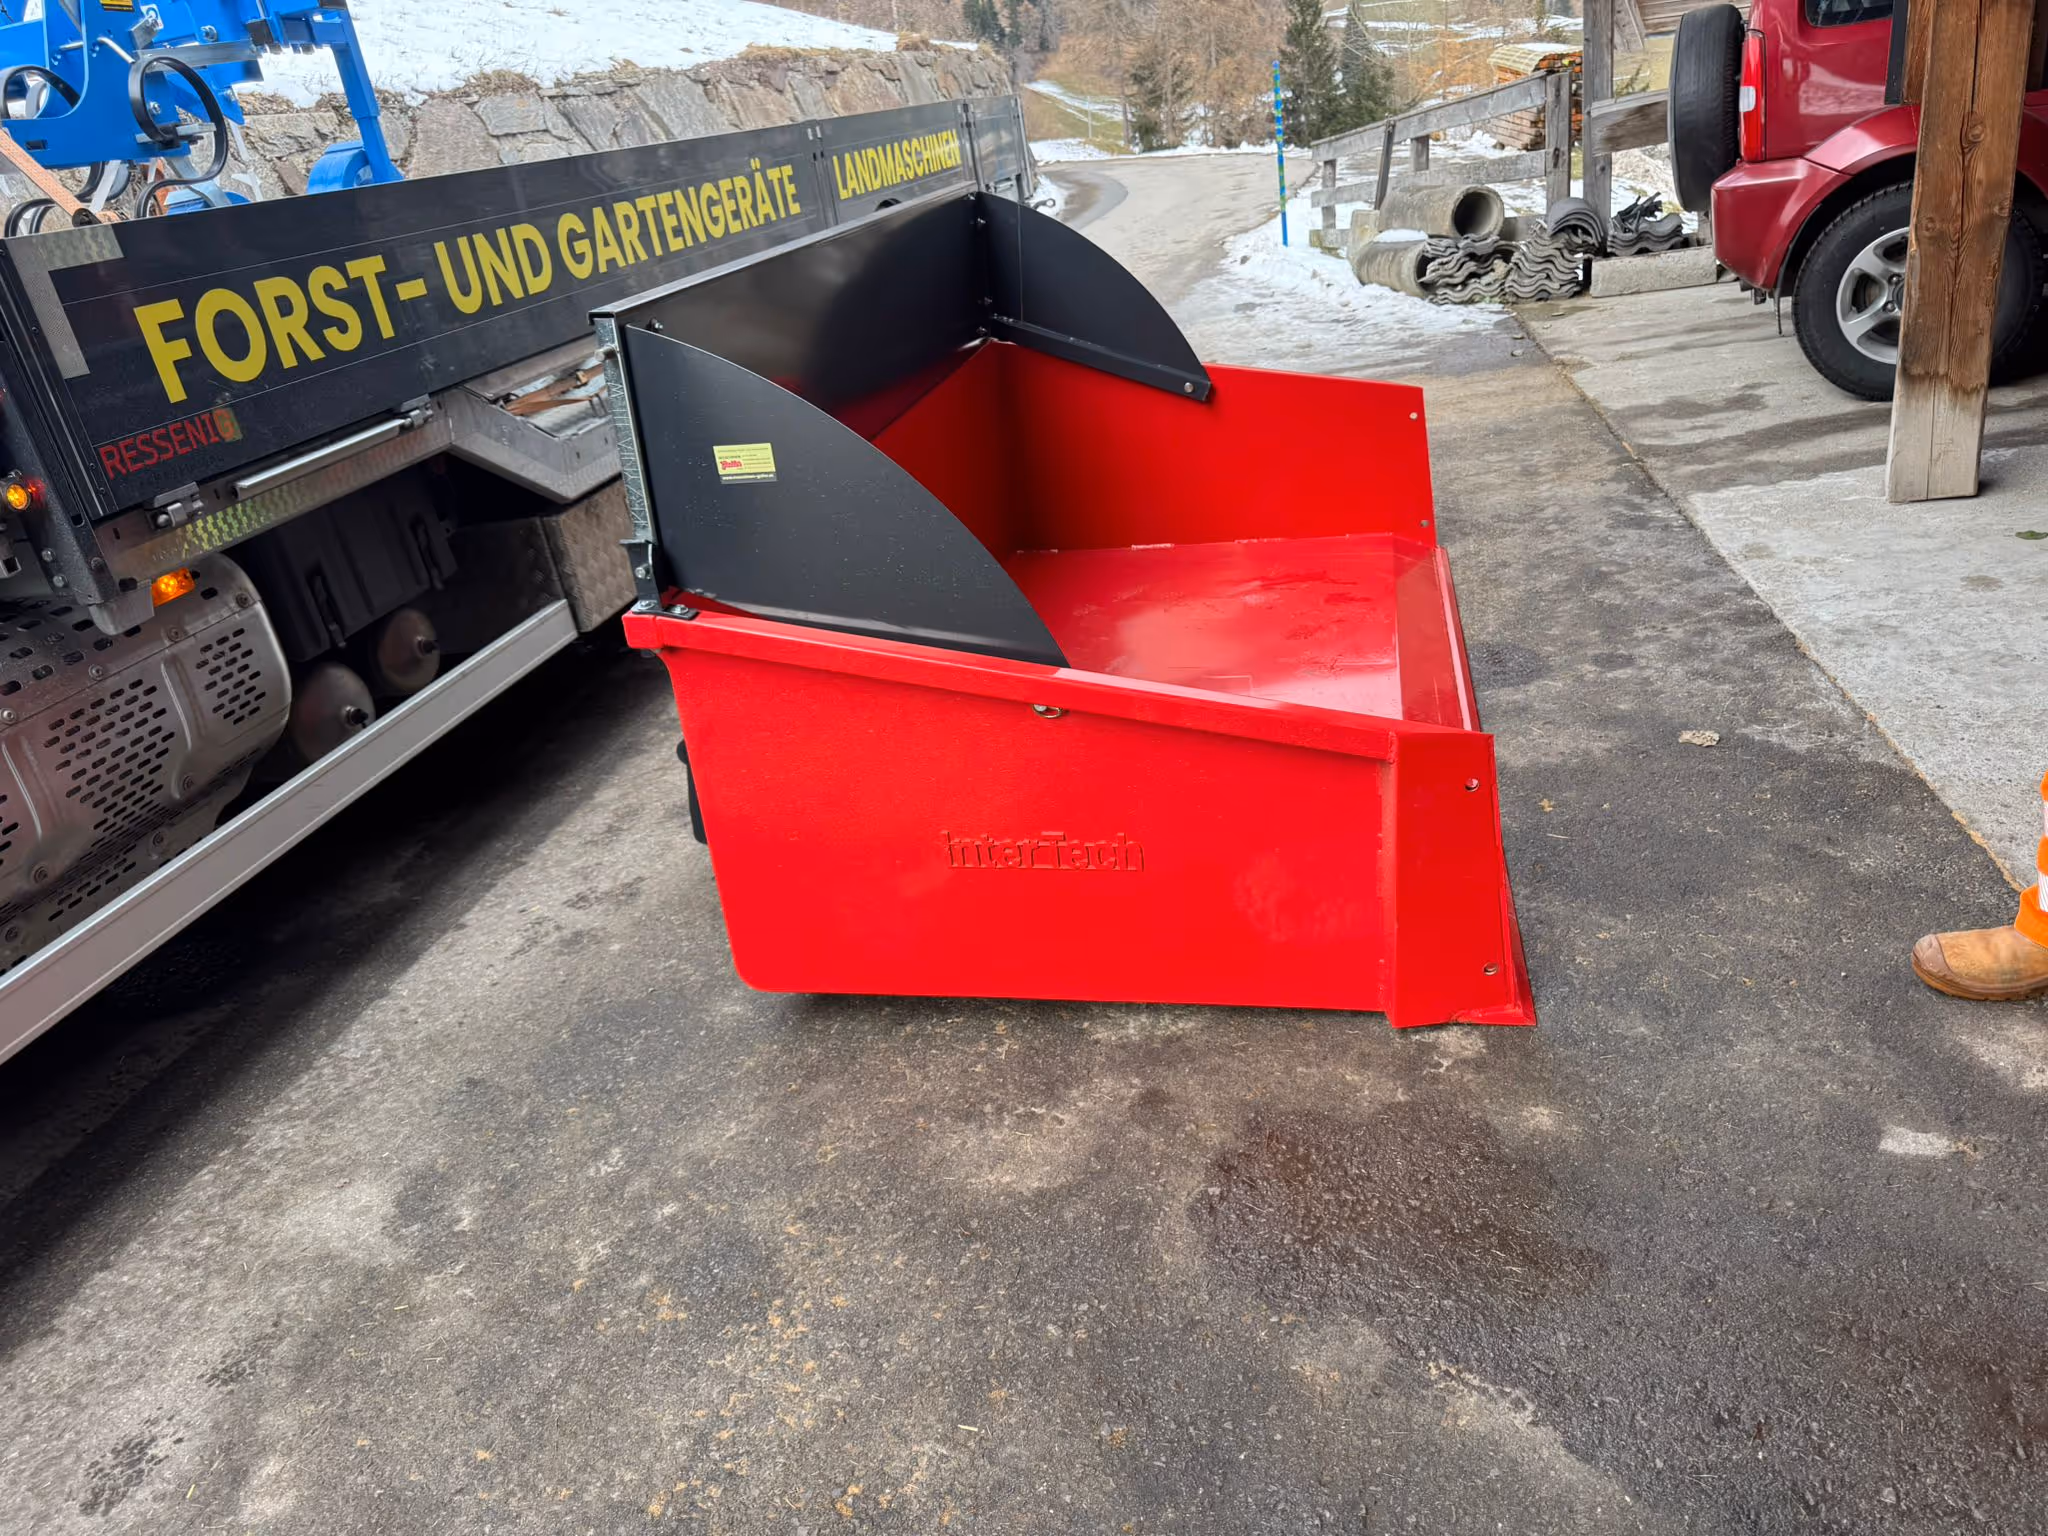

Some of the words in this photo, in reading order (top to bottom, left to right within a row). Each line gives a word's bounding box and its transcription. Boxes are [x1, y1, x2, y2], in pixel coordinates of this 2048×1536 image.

[833, 129, 961, 200] LANDMASCHINEN
[134, 239, 427, 403] FORST-
[437, 213, 553, 314] UND
[558, 158, 802, 280] GARTENGERÄTE
[99, 408, 237, 480] RESSENIG
